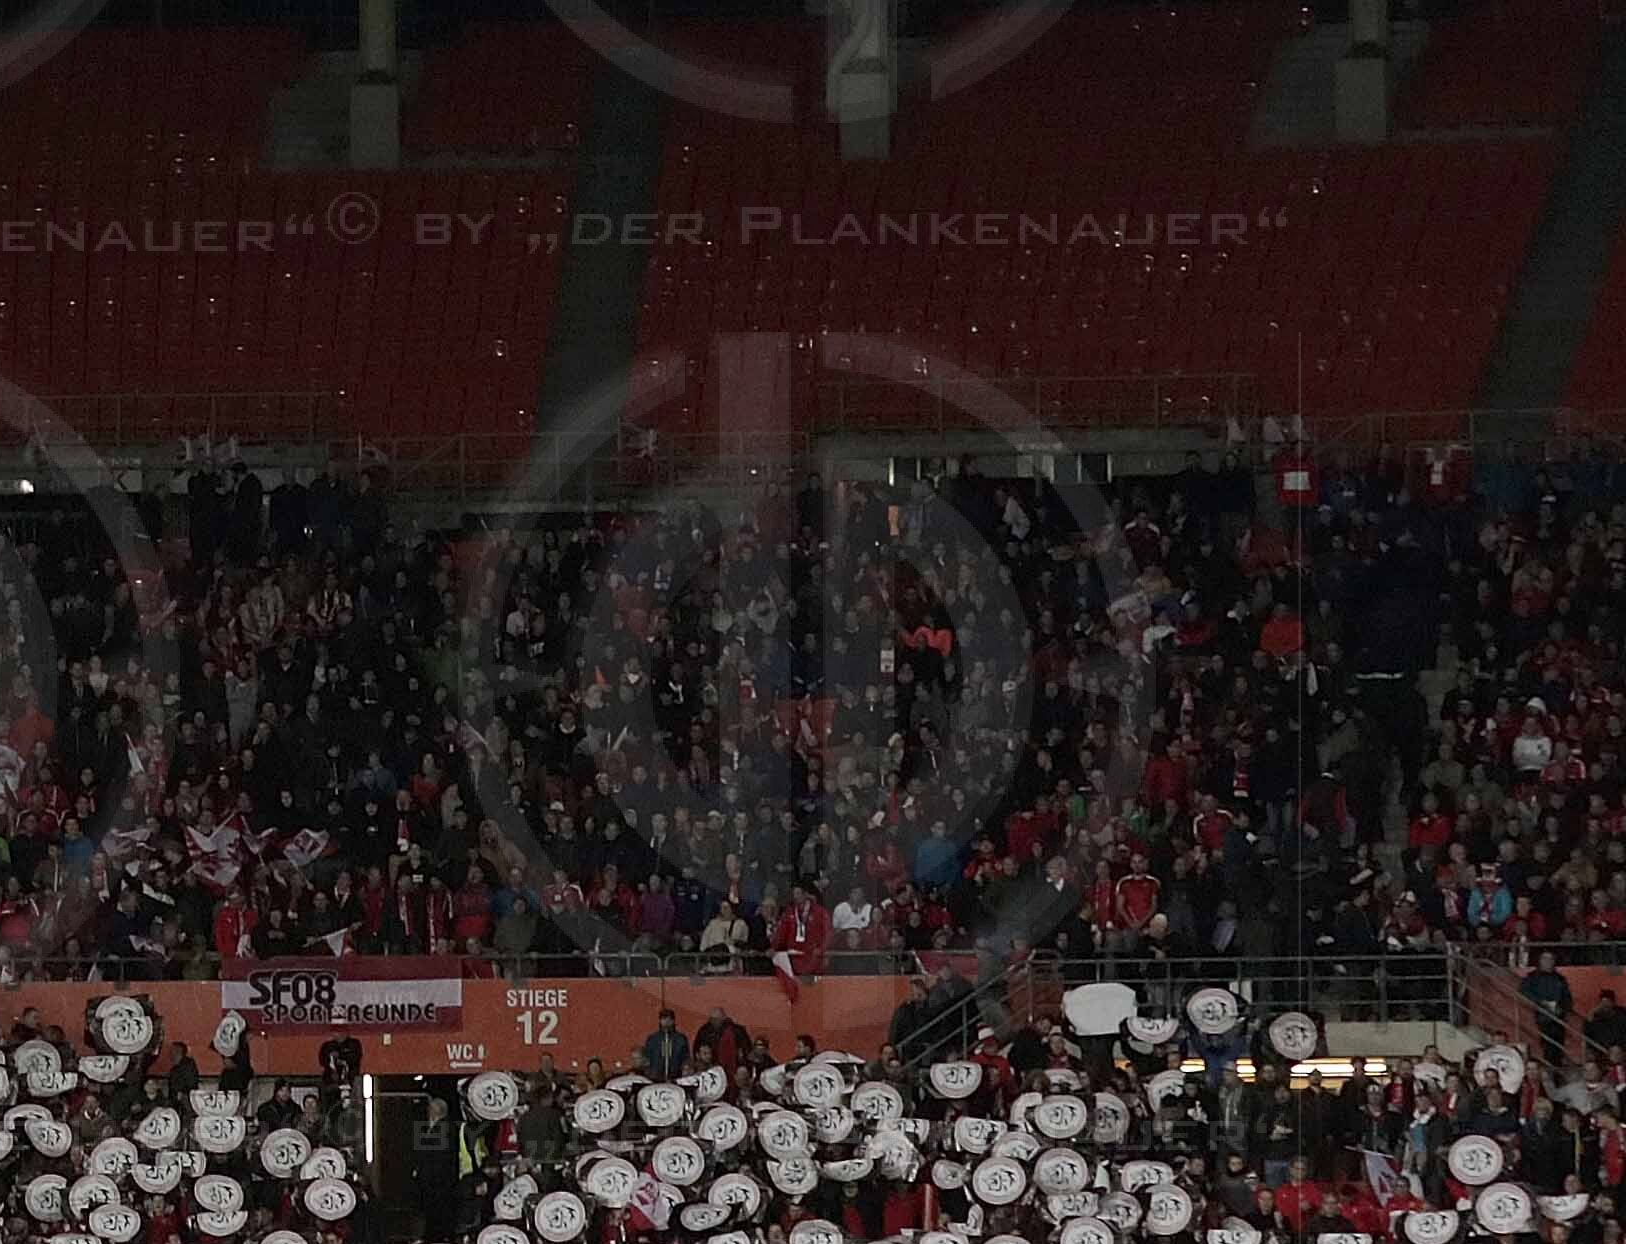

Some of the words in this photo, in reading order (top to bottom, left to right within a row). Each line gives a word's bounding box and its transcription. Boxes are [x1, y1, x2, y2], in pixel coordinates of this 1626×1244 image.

[249, 971, 336, 1006] SF08
[507, 989, 568, 1008] STIEGE
[262, 1003, 436, 1023] SPORTREUNDE
[517, 1010, 559, 1045] 12
[447, 1044, 474, 1060] WC
